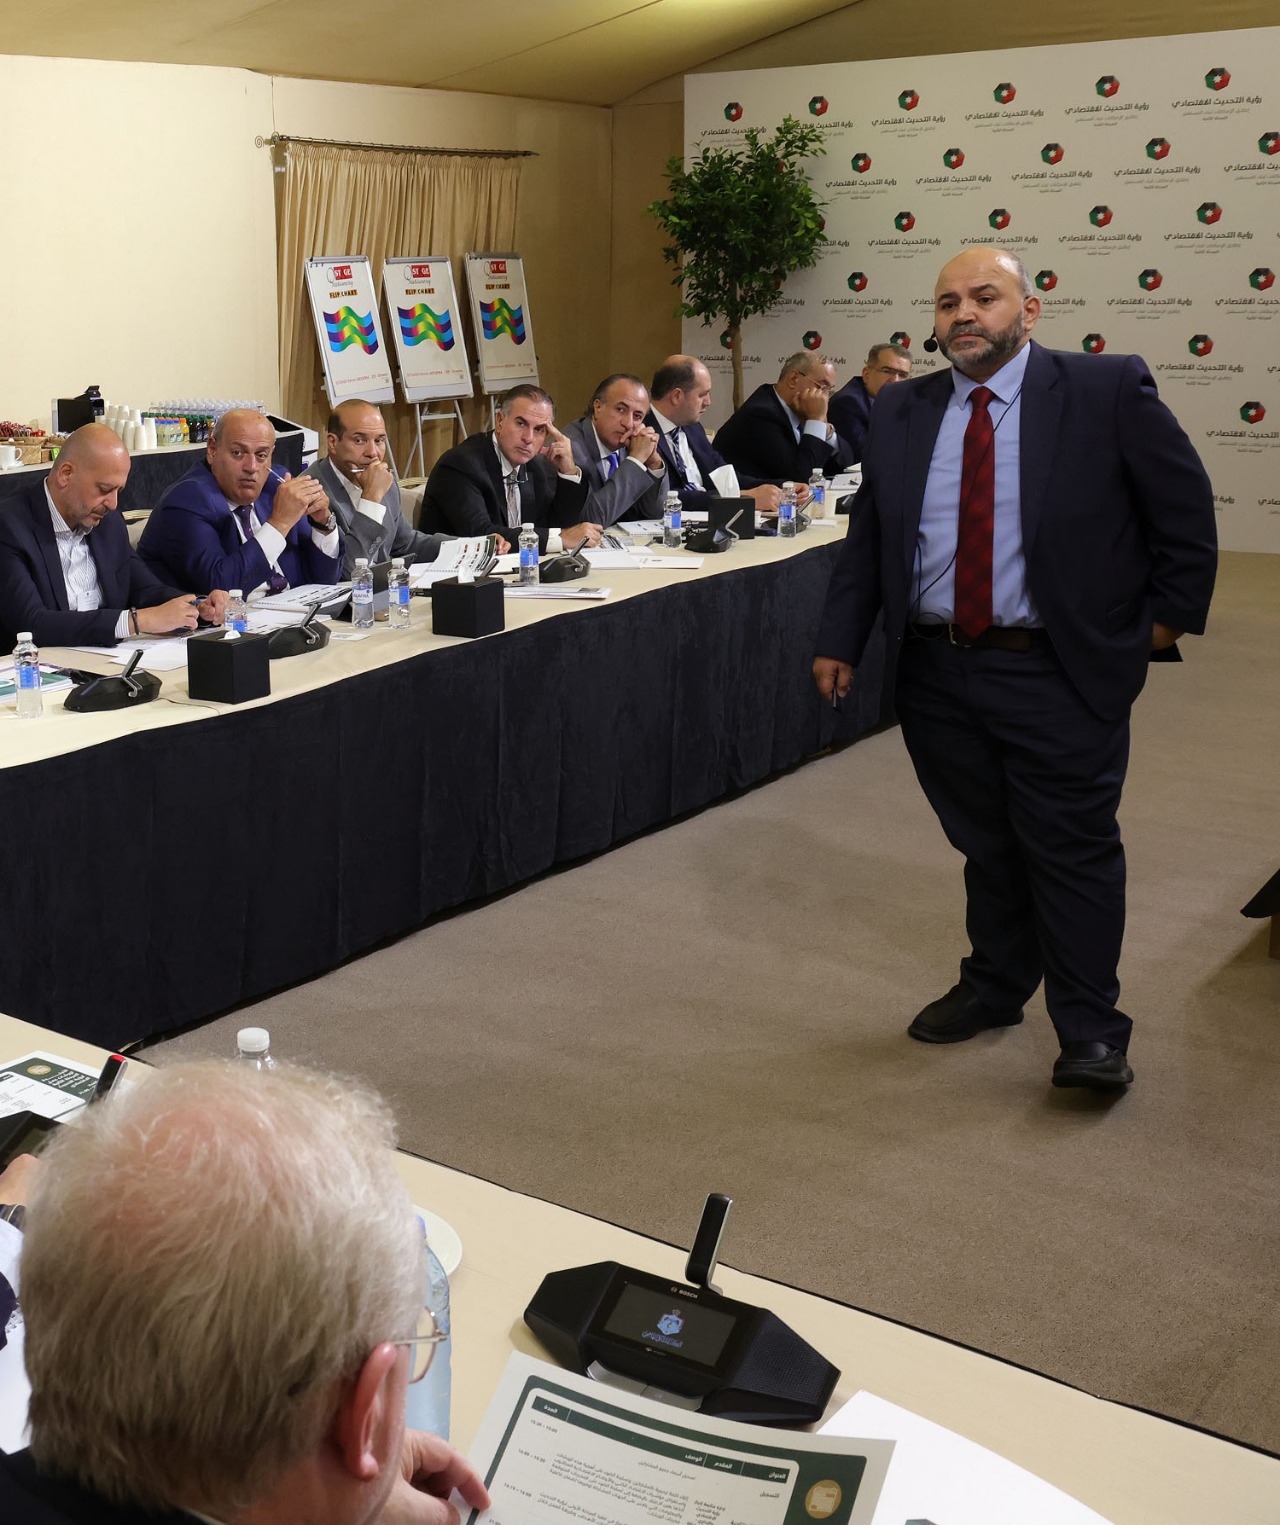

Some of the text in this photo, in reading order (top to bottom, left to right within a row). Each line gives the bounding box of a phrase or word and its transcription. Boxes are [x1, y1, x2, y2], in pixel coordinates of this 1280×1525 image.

[1172, 96, 1262, 108] رؤية التحديث الاقتصادي
[1065, 103, 1149, 115] رؤية التحديث الاقتصادي
[965, 109, 1044, 121] رؤية التحديث الاقتصادي
[872, 118, 904, 126] الاقتصادي
[906, 116, 931, 124] التحديث
[1114, 166, 1200, 176] رؤية التحديث الاقتصادي
[1224, 163, 1264, 172] الاقتصادي
[1012, 170, 1092, 181] رؤية التحديث الاقتصادي
[826, 180, 857, 188] الاقتصادي
[859, 179, 882, 187] التحديث
[916, 176, 949, 184] الاقتصادي
[1205, 232, 1235, 240] التحديث
[1238, 231, 1253, 239] رؤية
[961, 237, 995, 245] الاقتصادي
[997, 236, 1022, 244] التحديث
[1071, 298, 1086, 306] رؤية
[1146, 298, 1175, 306] التحديث
[1215, 298, 1254, 306] الاقتصادي
[679, 1290, 698, 1298] BOSCH
